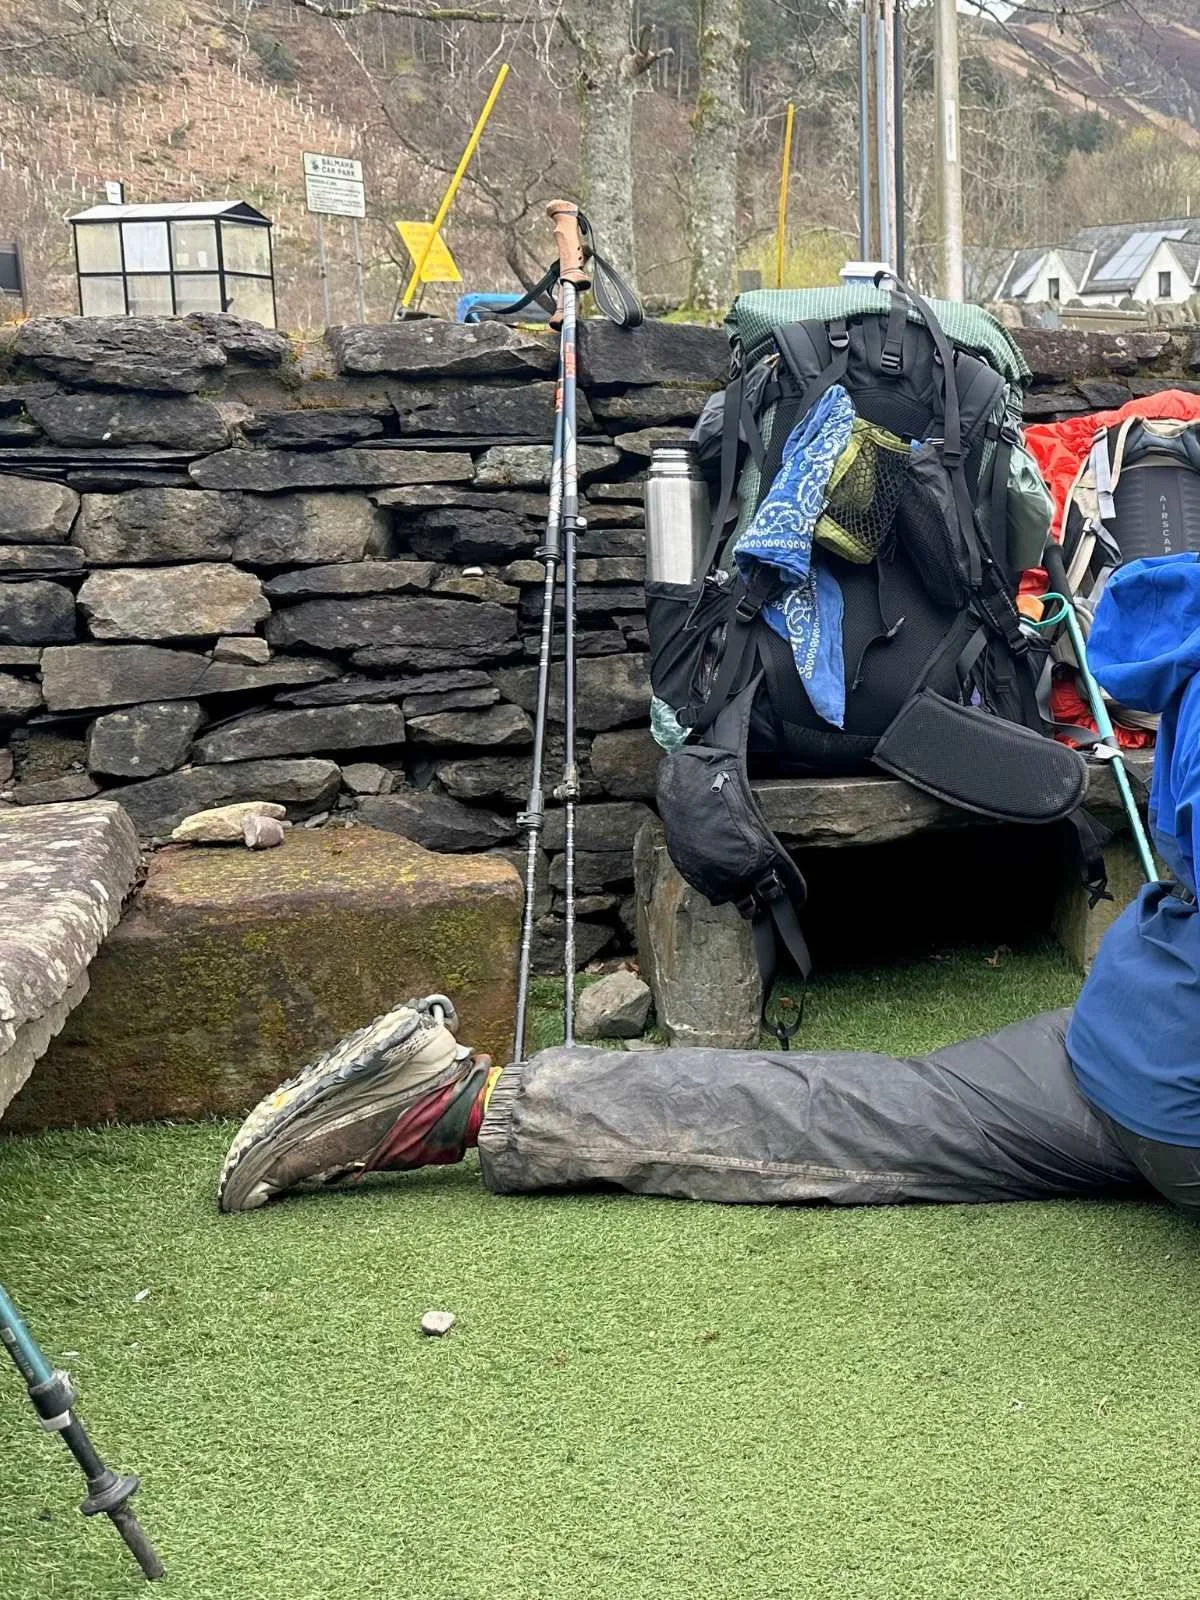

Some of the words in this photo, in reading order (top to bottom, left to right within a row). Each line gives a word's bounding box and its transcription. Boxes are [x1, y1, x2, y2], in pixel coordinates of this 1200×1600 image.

[321, 158, 354, 169] BALMAHA
[321, 166, 335, 175] CAR
[337, 168, 355, 177] PARK
